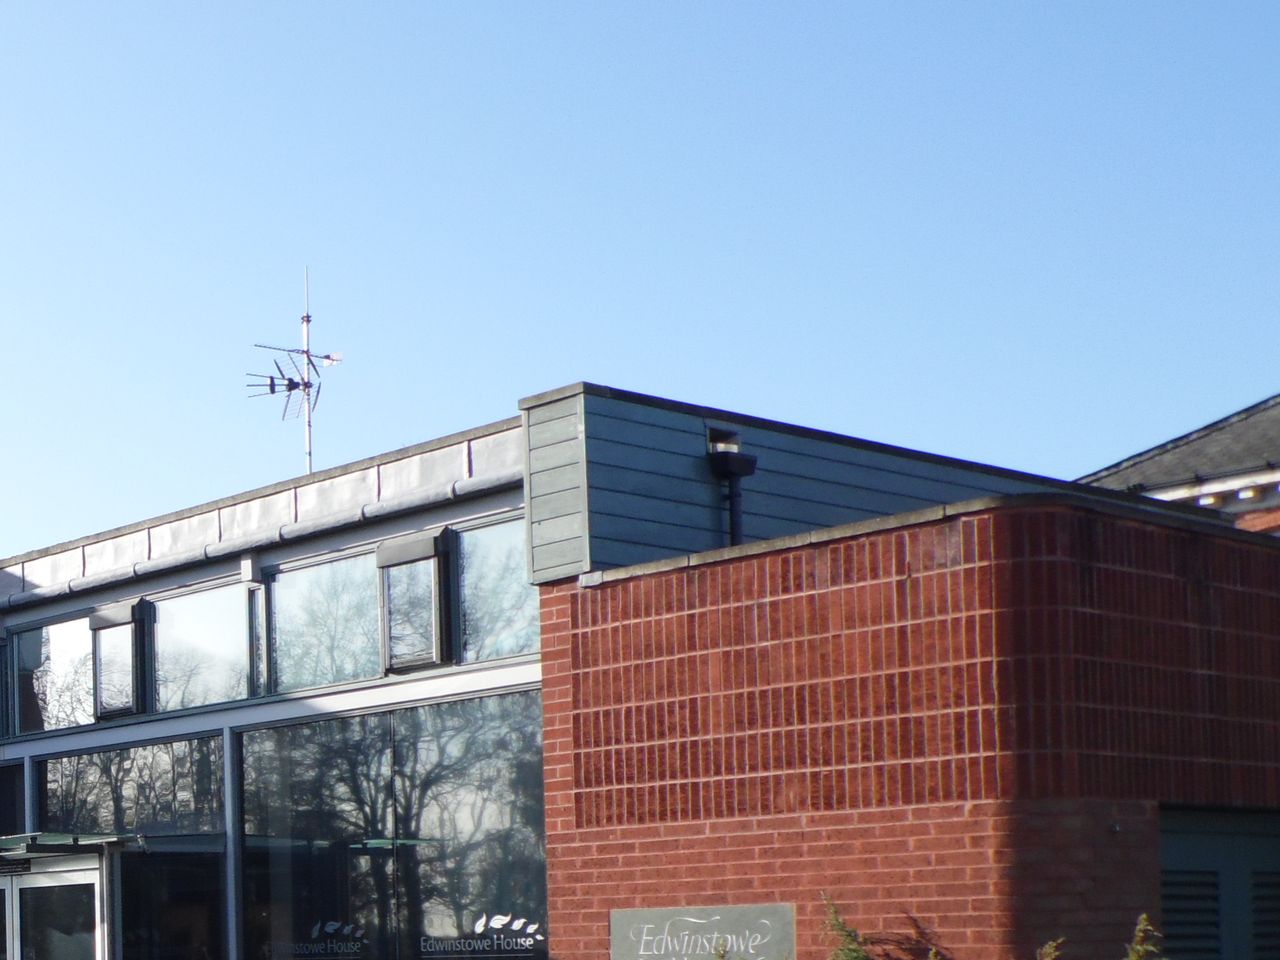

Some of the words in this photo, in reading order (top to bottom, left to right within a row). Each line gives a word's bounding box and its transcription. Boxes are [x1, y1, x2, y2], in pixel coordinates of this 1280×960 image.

[420, 936, 490, 952] Edwinstowe
[494, 934, 533, 950] House
[632, 916, 768, 955] Edwinstowe
[267, 941, 325, 954] dwinstowe
[328, 940, 360, 953] House
